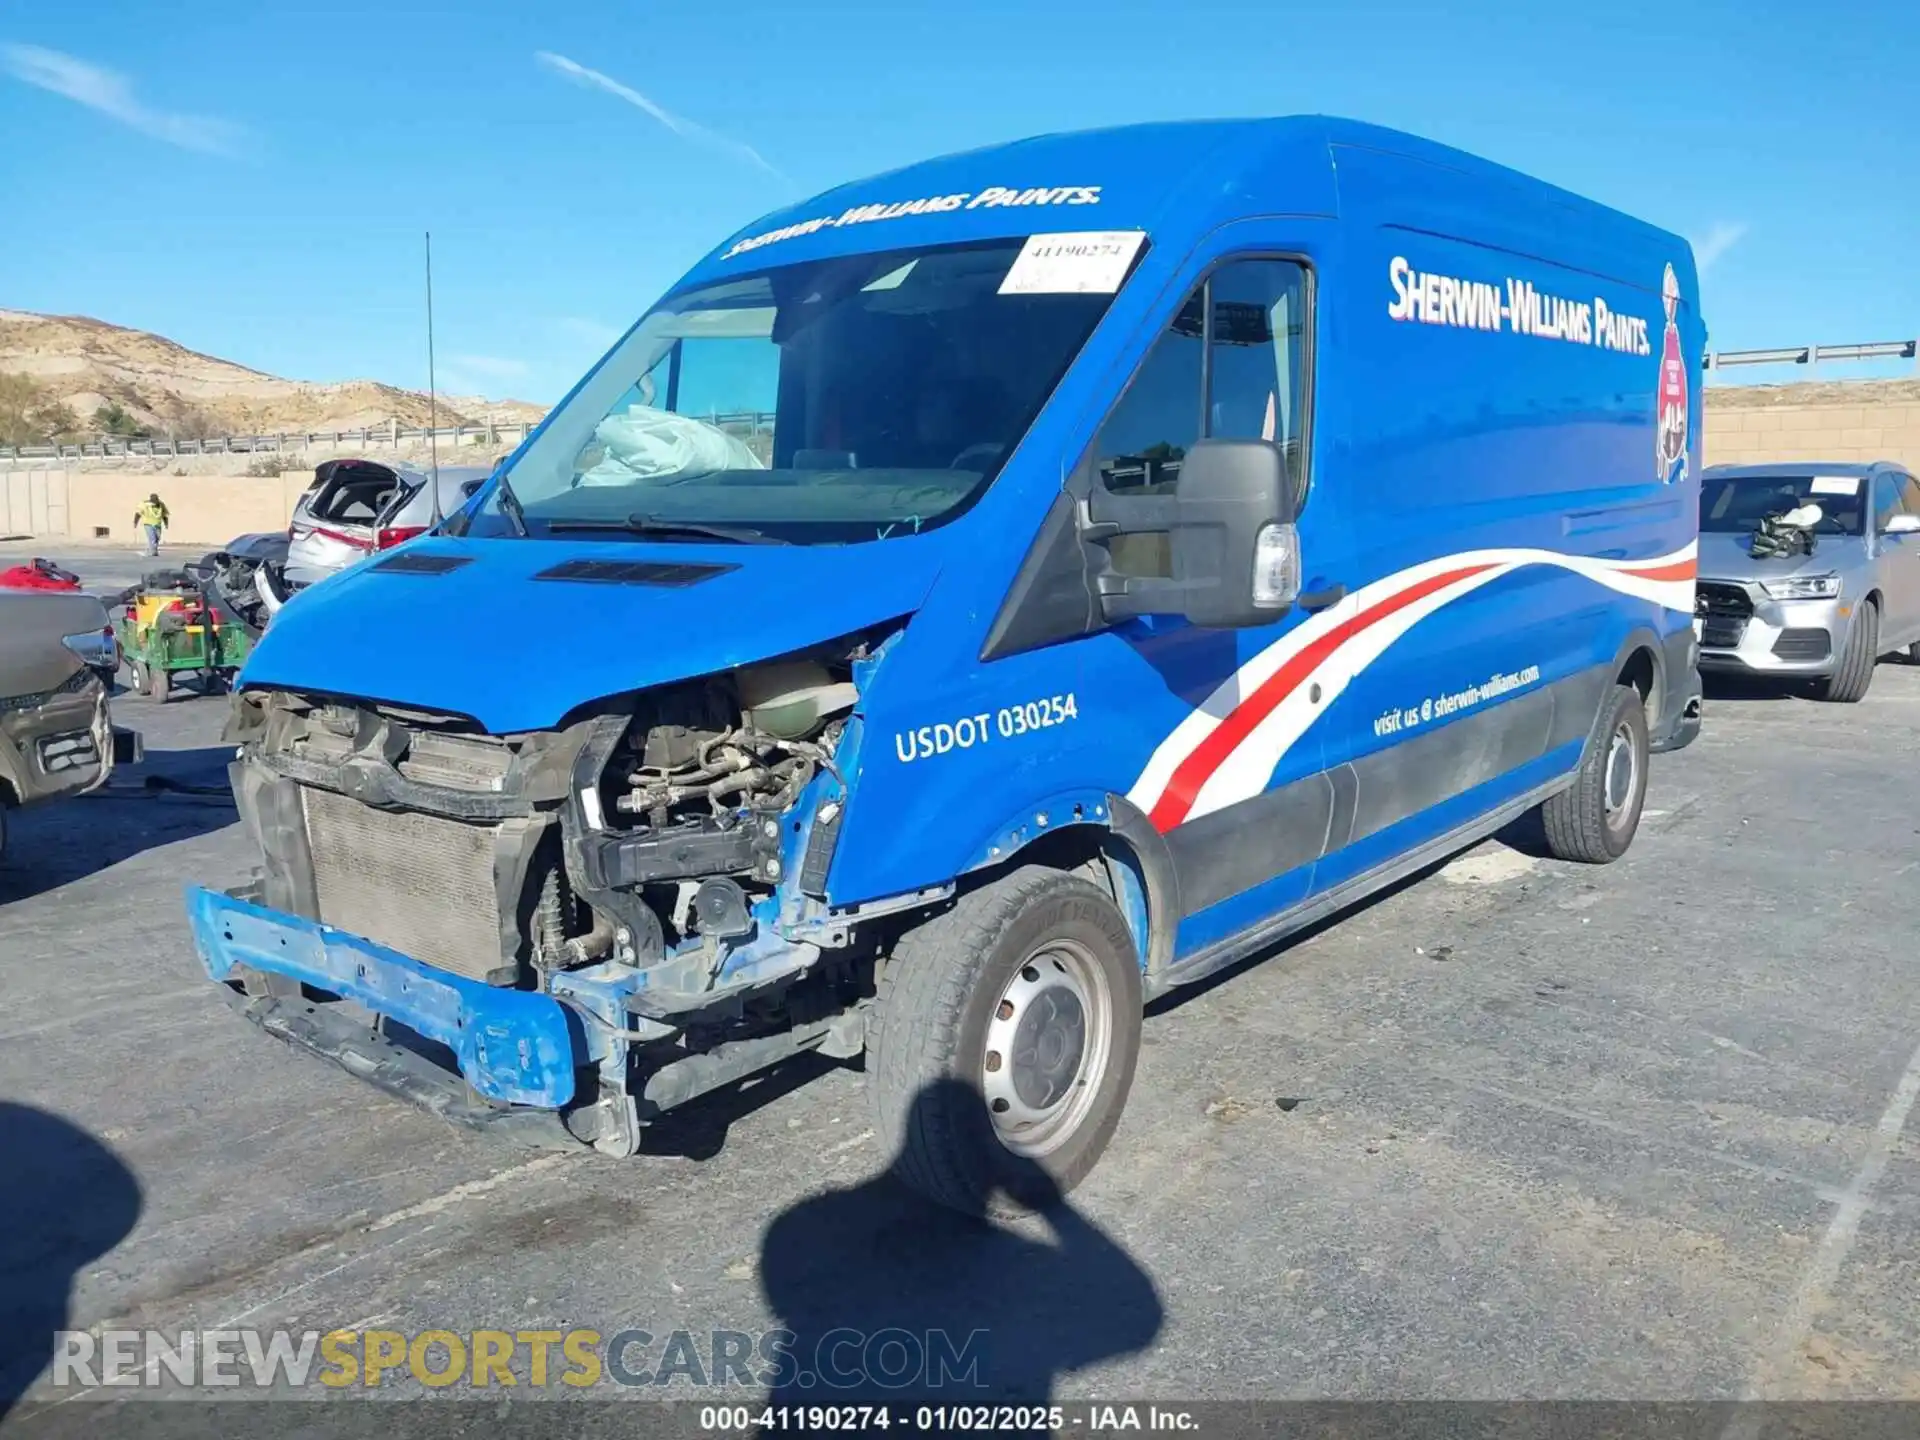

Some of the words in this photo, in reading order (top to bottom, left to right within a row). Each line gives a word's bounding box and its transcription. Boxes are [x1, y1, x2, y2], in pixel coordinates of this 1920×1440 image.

[1032, 244, 1122, 259] 41190274
[1388, 256, 1592, 345] SHERWIN-WILLIAMS
[895, 713, 990, 763] USDOT
[998, 692, 1077, 737] 030254
[1374, 704, 1402, 736] visit
[1404, 706, 1419, 729] us
[1434, 664, 1540, 718] sherwin-williams.com
